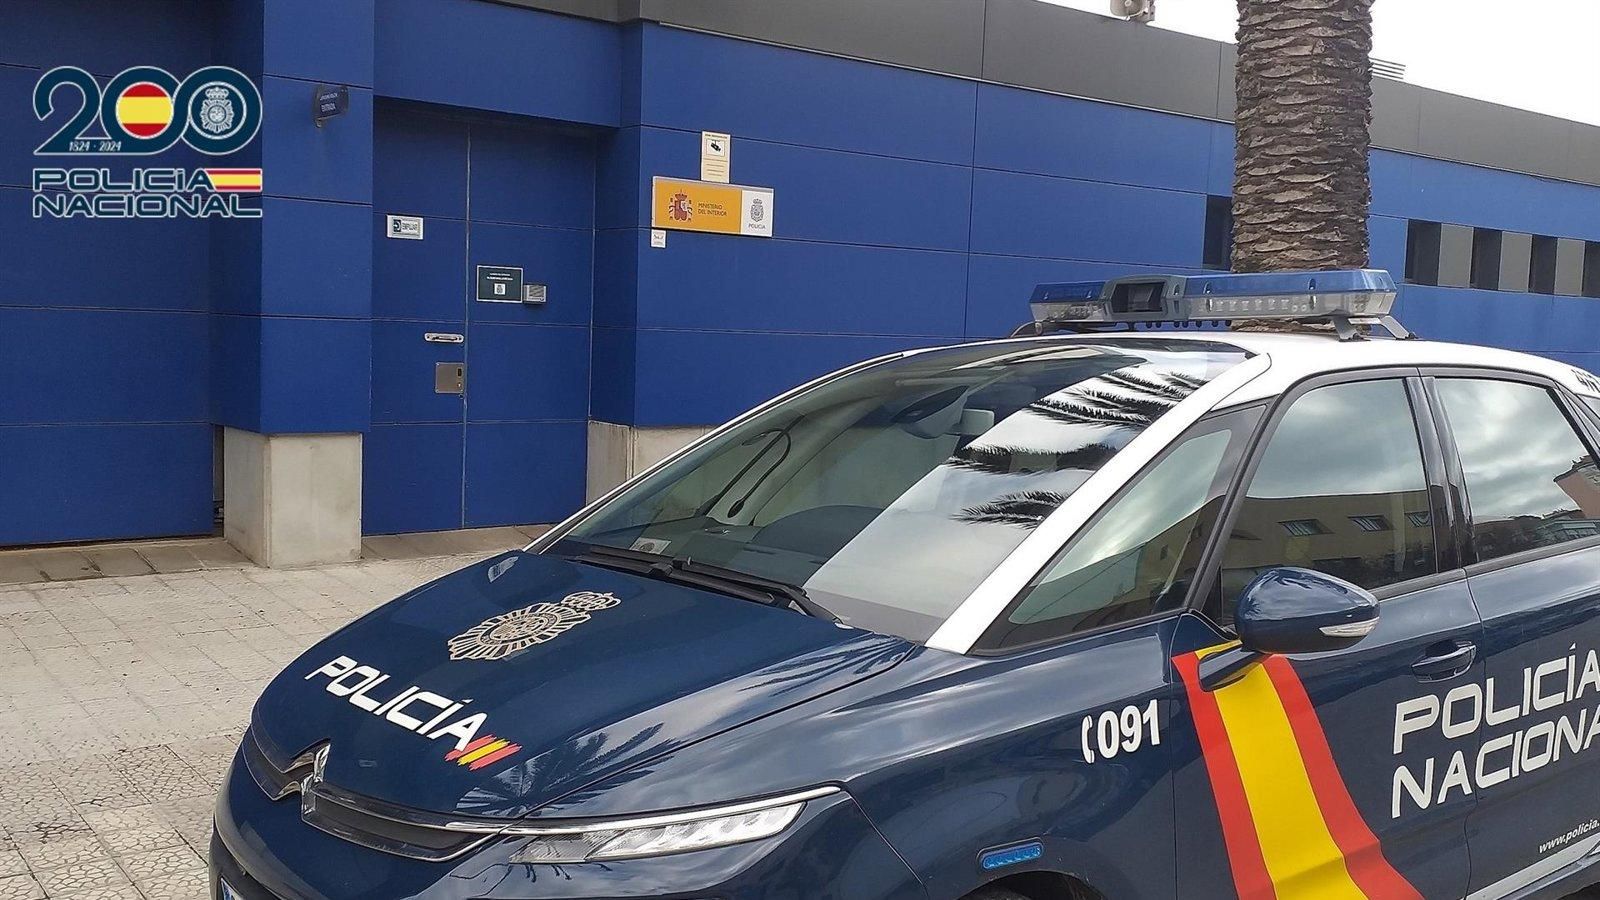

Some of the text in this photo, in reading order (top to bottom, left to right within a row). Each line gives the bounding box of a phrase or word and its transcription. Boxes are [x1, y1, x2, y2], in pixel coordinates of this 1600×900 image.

[698, 202, 723, 210] MINISTERIO
[707, 209, 727, 217] INTERIOR
[304, 655, 488, 752] POLICÍA
[1393, 642, 1600, 755] POLICÍA
[1097, 698, 1161, 759] 091
[1539, 819, 1600, 854] www.policia.
